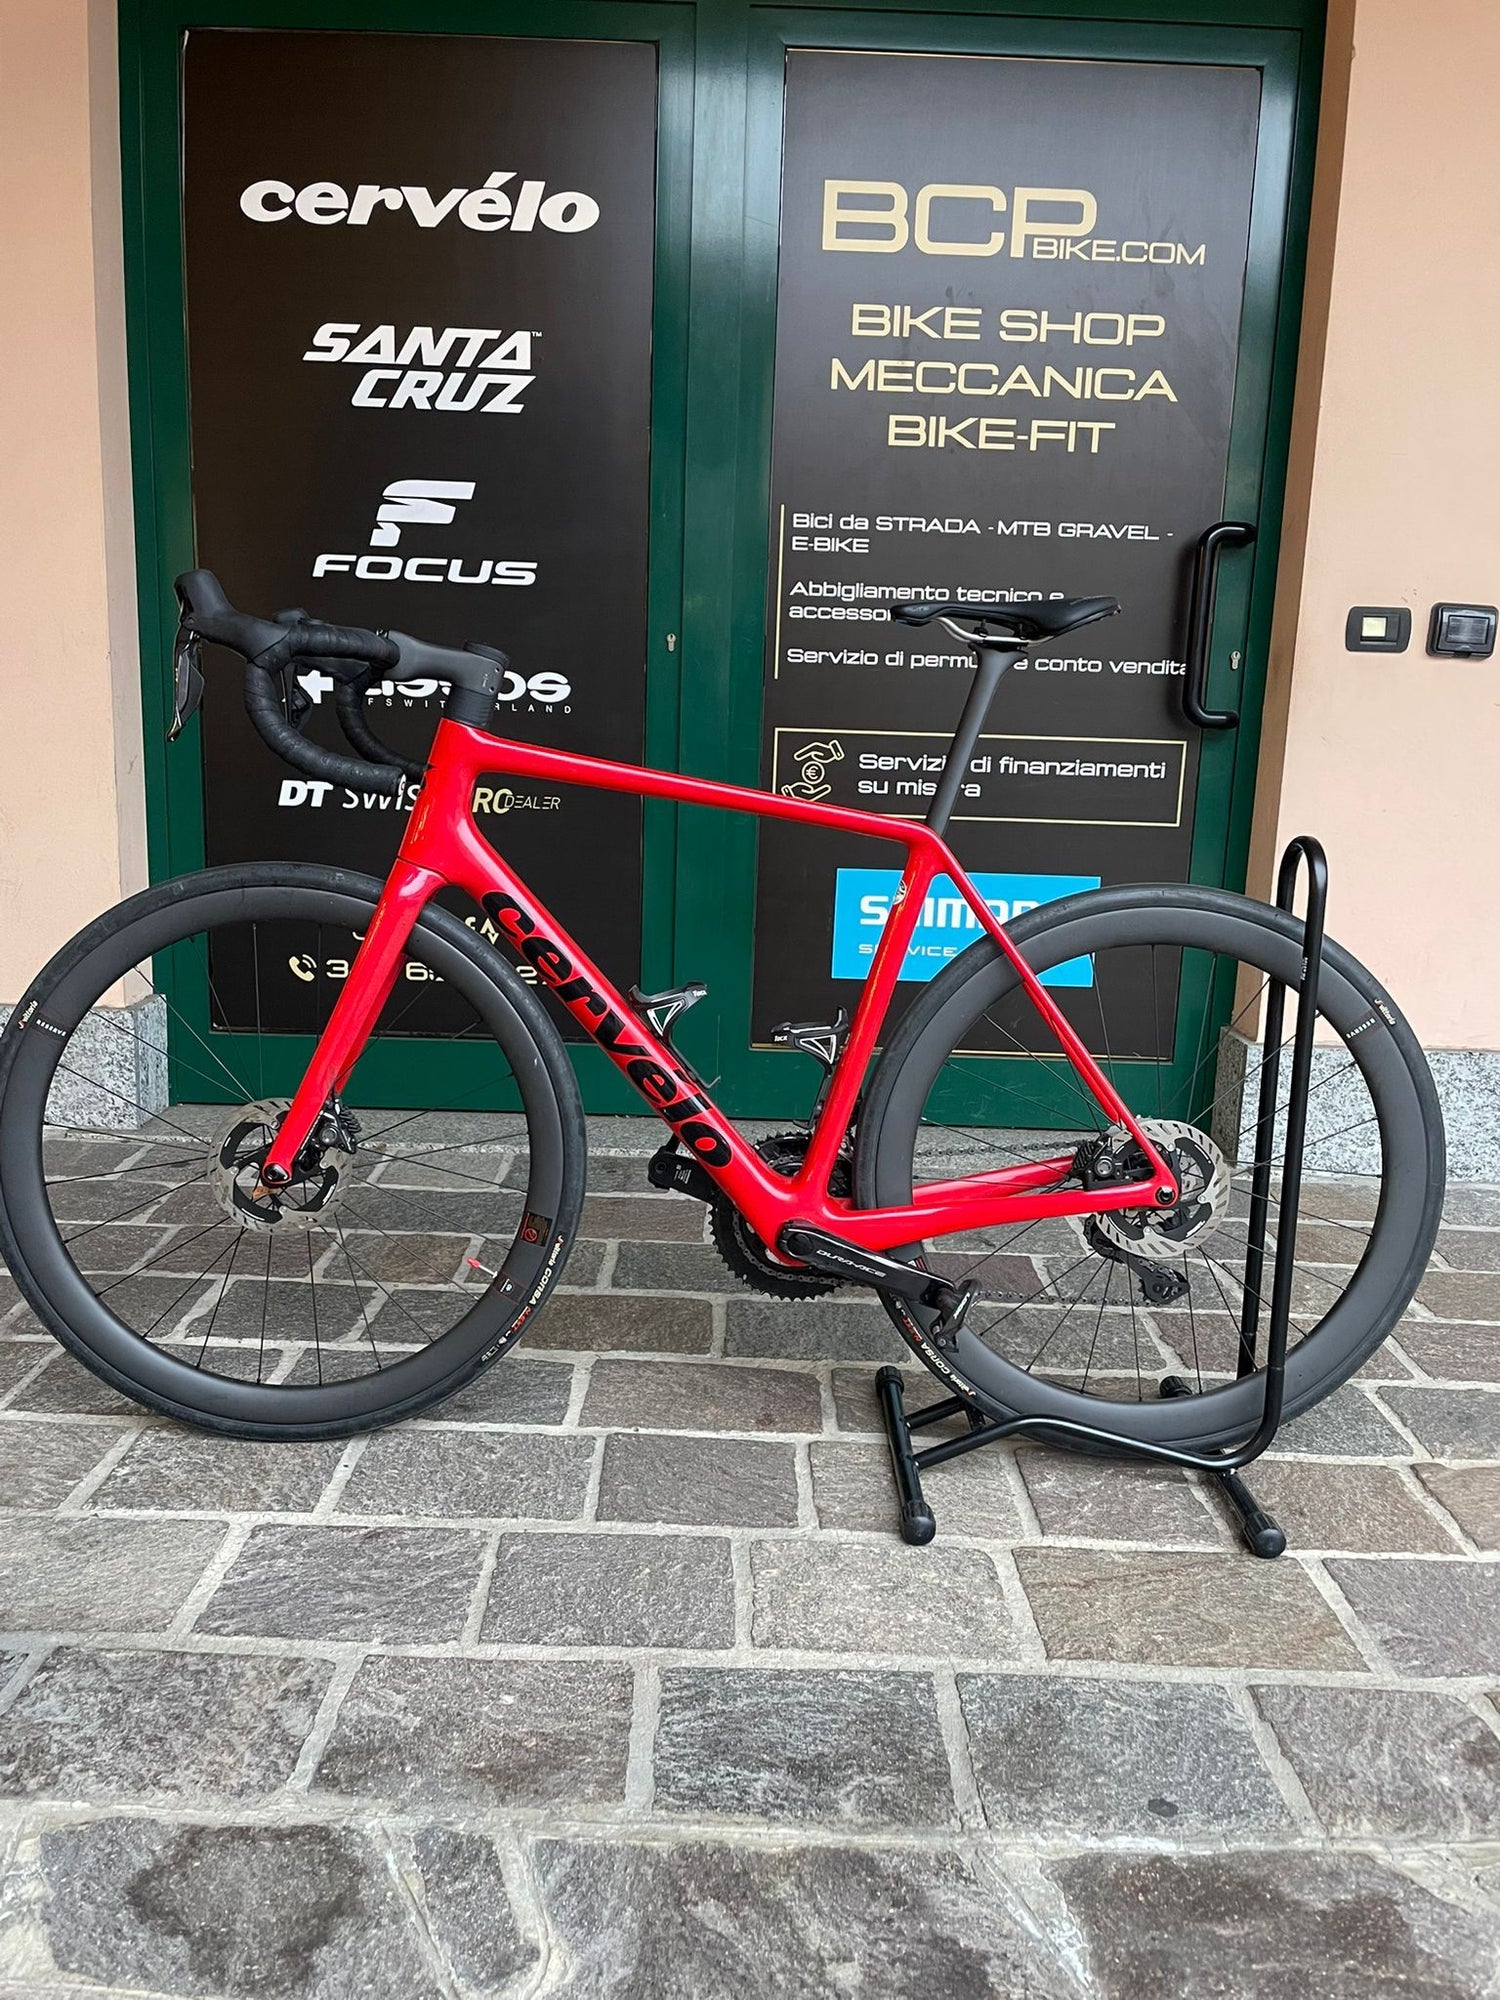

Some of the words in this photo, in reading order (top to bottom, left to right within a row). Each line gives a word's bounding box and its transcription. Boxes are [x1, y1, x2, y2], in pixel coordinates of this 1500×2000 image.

[240, 172, 600, 232] cervélo
[852, 304, 982, 339] BIKE
[1000, 310, 1165, 345] SHOP
[352, 369, 536, 413] CRUZ
[831, 358, 1177, 402] MECCANICA
[889, 415, 1115, 452] BIKE-FIT
[793, 513, 833, 529] Bici
[840, 514, 869, 530] da
[876, 516, 981, 534] STRADA
[1058, 523, 1159, 540] GRAVEL
[792, 536, 869, 553] E-BIKE
[313, 554, 537, 585] FOCUS
[790, 581, 949, 601] Abbigliamento
[955, 587, 1043, 603] tecnico
[787, 649, 878, 665] Servizio
[885, 651, 903, 666] di
[1035, 658, 1102, 672] conto
[859, 754, 946, 771] Servizi
[970, 757, 991, 774] di
[999, 756, 1166, 778] finanziamenti
[278, 780, 334, 807] DT
[504, 795, 561, 810] DEALER
[858, 781, 888, 794] su
[896, 779, 981, 797] misa
[858, 944, 958, 957] SVICE
[921, 1342, 951, 1375] CORSA
